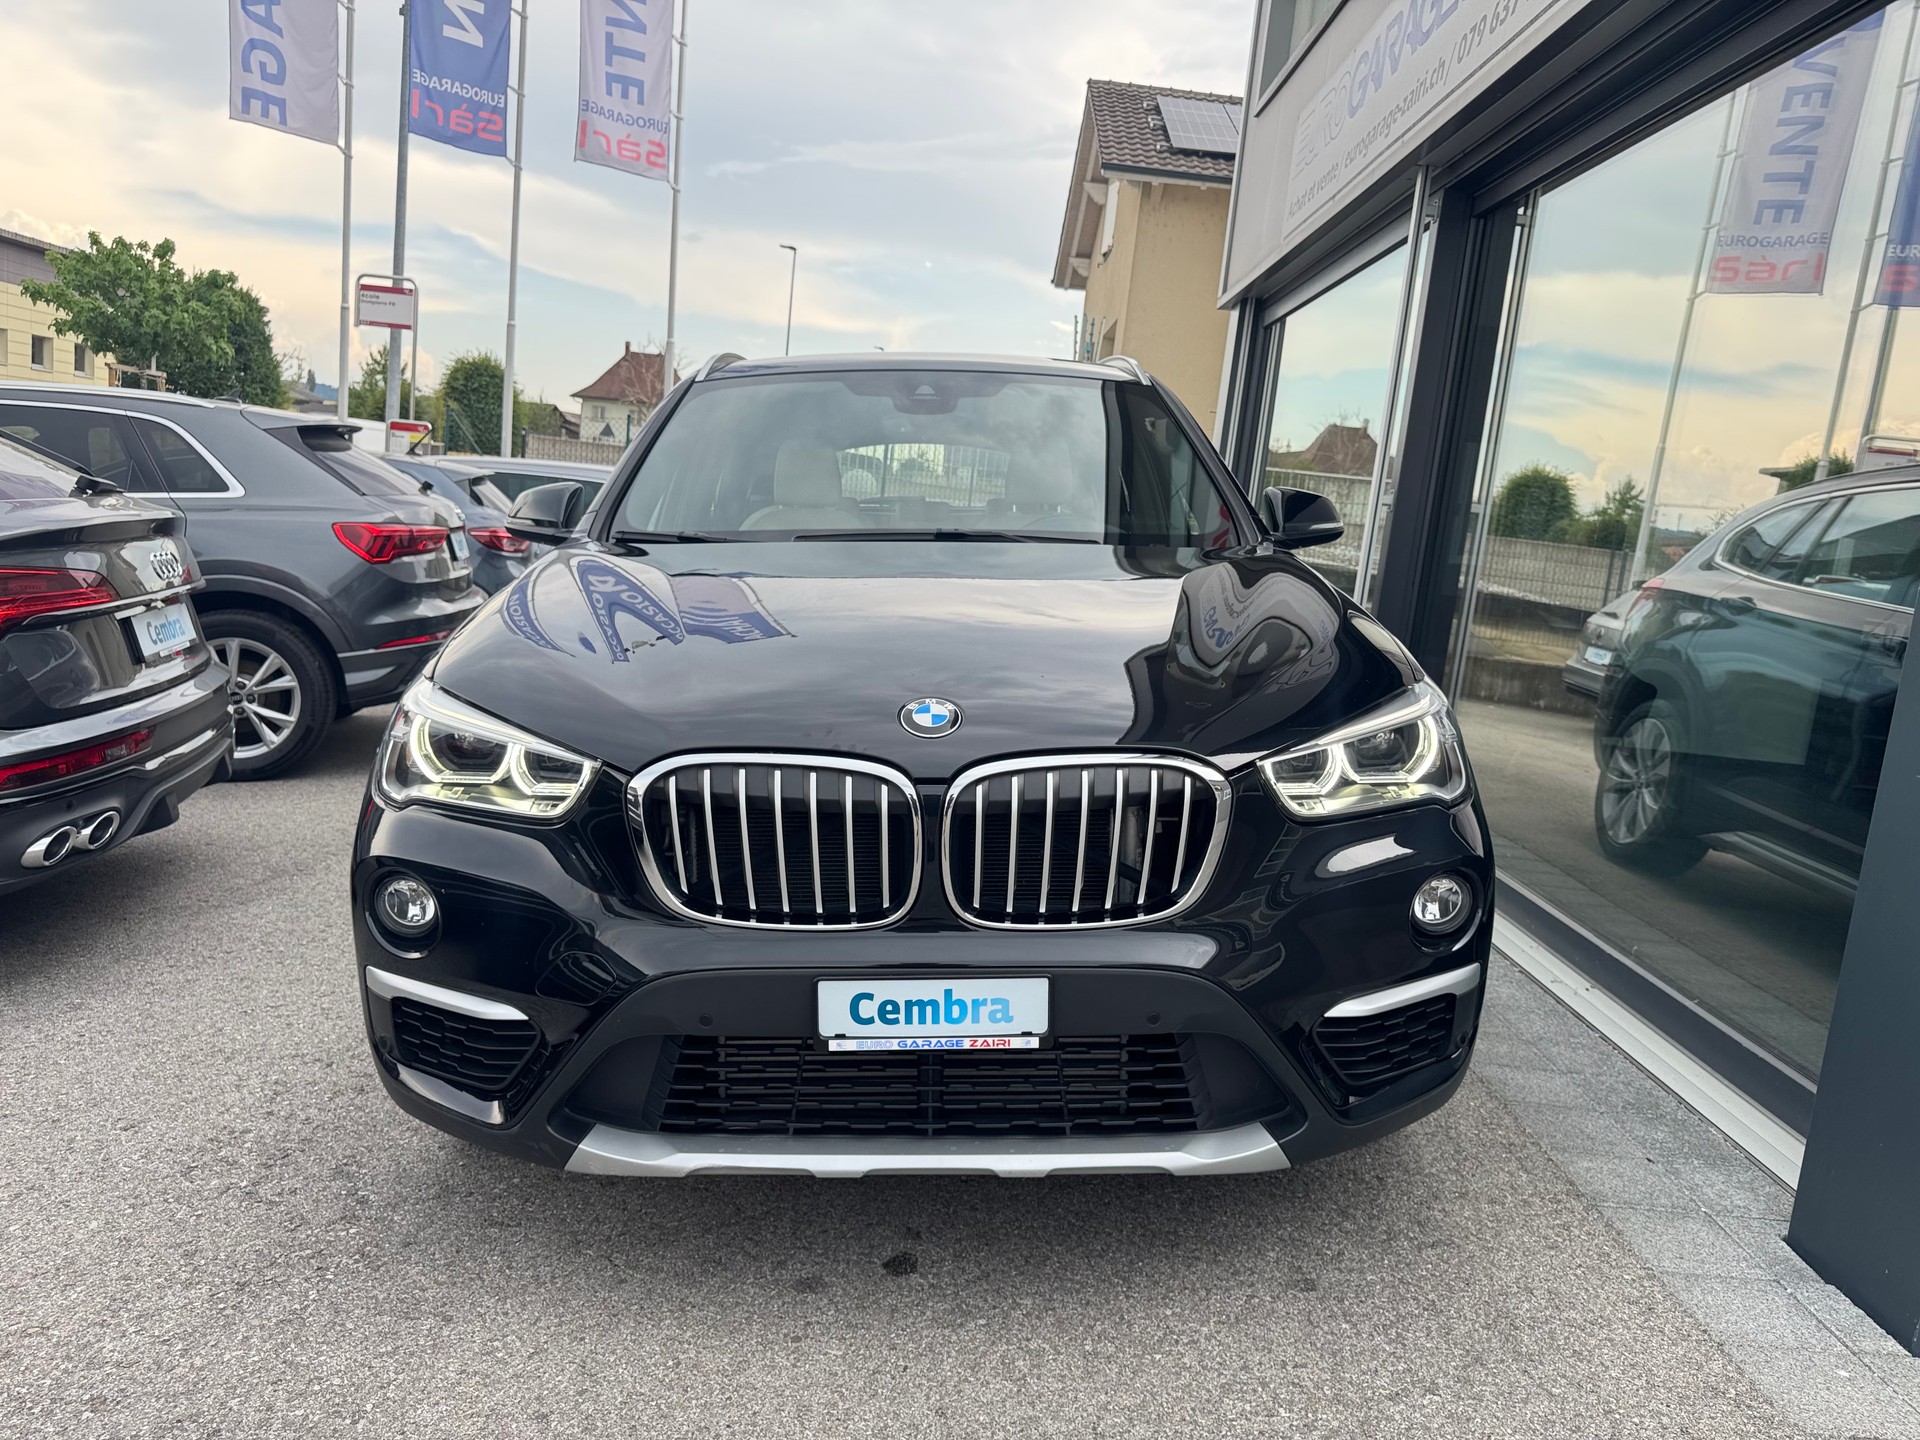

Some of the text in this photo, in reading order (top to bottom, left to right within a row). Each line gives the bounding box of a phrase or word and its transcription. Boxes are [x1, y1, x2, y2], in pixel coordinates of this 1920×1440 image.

[1457, 14, 1488, 65] 079
[1753, 36, 1847, 226] VENTE
[1717, 231, 1829, 249] EUROGARAGE
[147, 615, 186, 646] Cembra
[849, 988, 1014, 1026] Cembra
[856, 1038, 1012, 1049] EURO GARAGE ZAIRI
